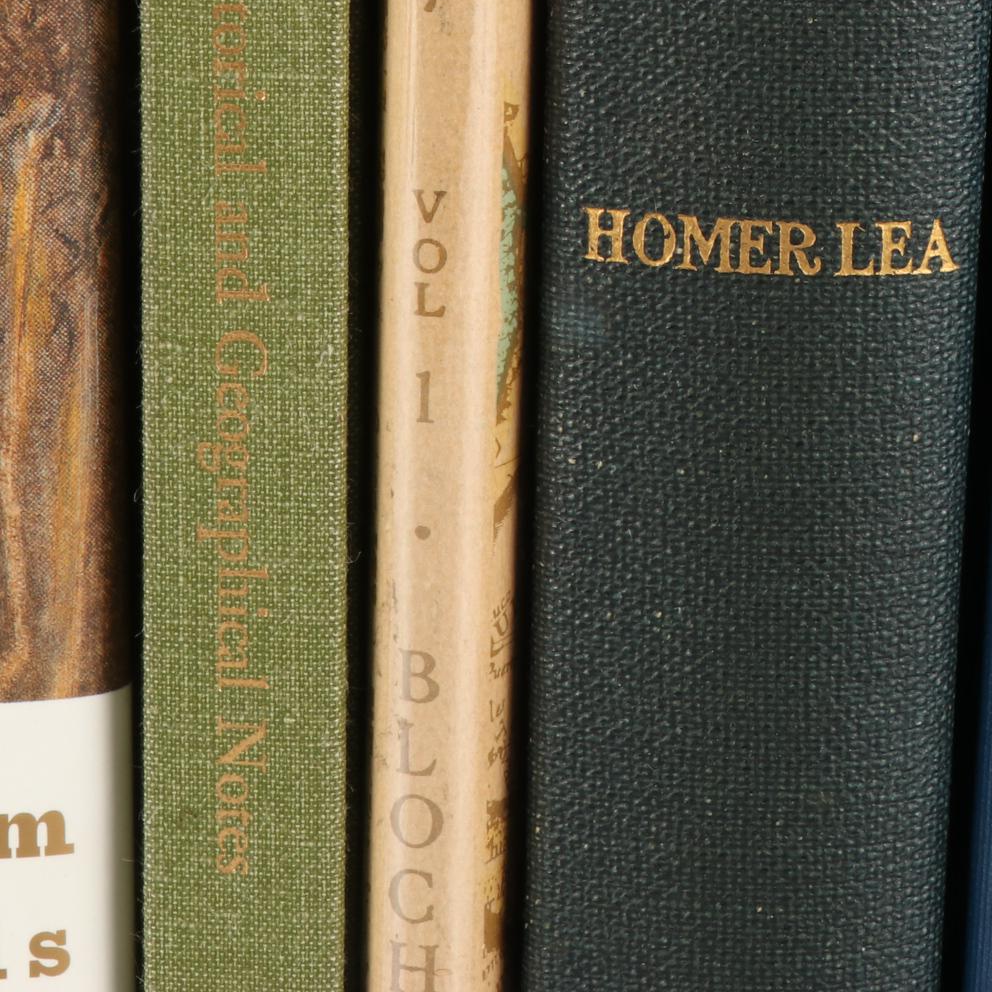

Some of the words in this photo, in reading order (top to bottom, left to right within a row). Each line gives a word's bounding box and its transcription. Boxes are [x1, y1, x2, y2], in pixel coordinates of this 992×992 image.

[214, 198, 272, 306] and
[411, 189, 449, 318] VOL
[582, 207, 822, 277] HOMER
[833, 218, 960, 278] LEA
[195, 329, 270, 691] Geographical
[214, 714, 269, 876] Notes
[386, 649, 445, 992] BLOCH
